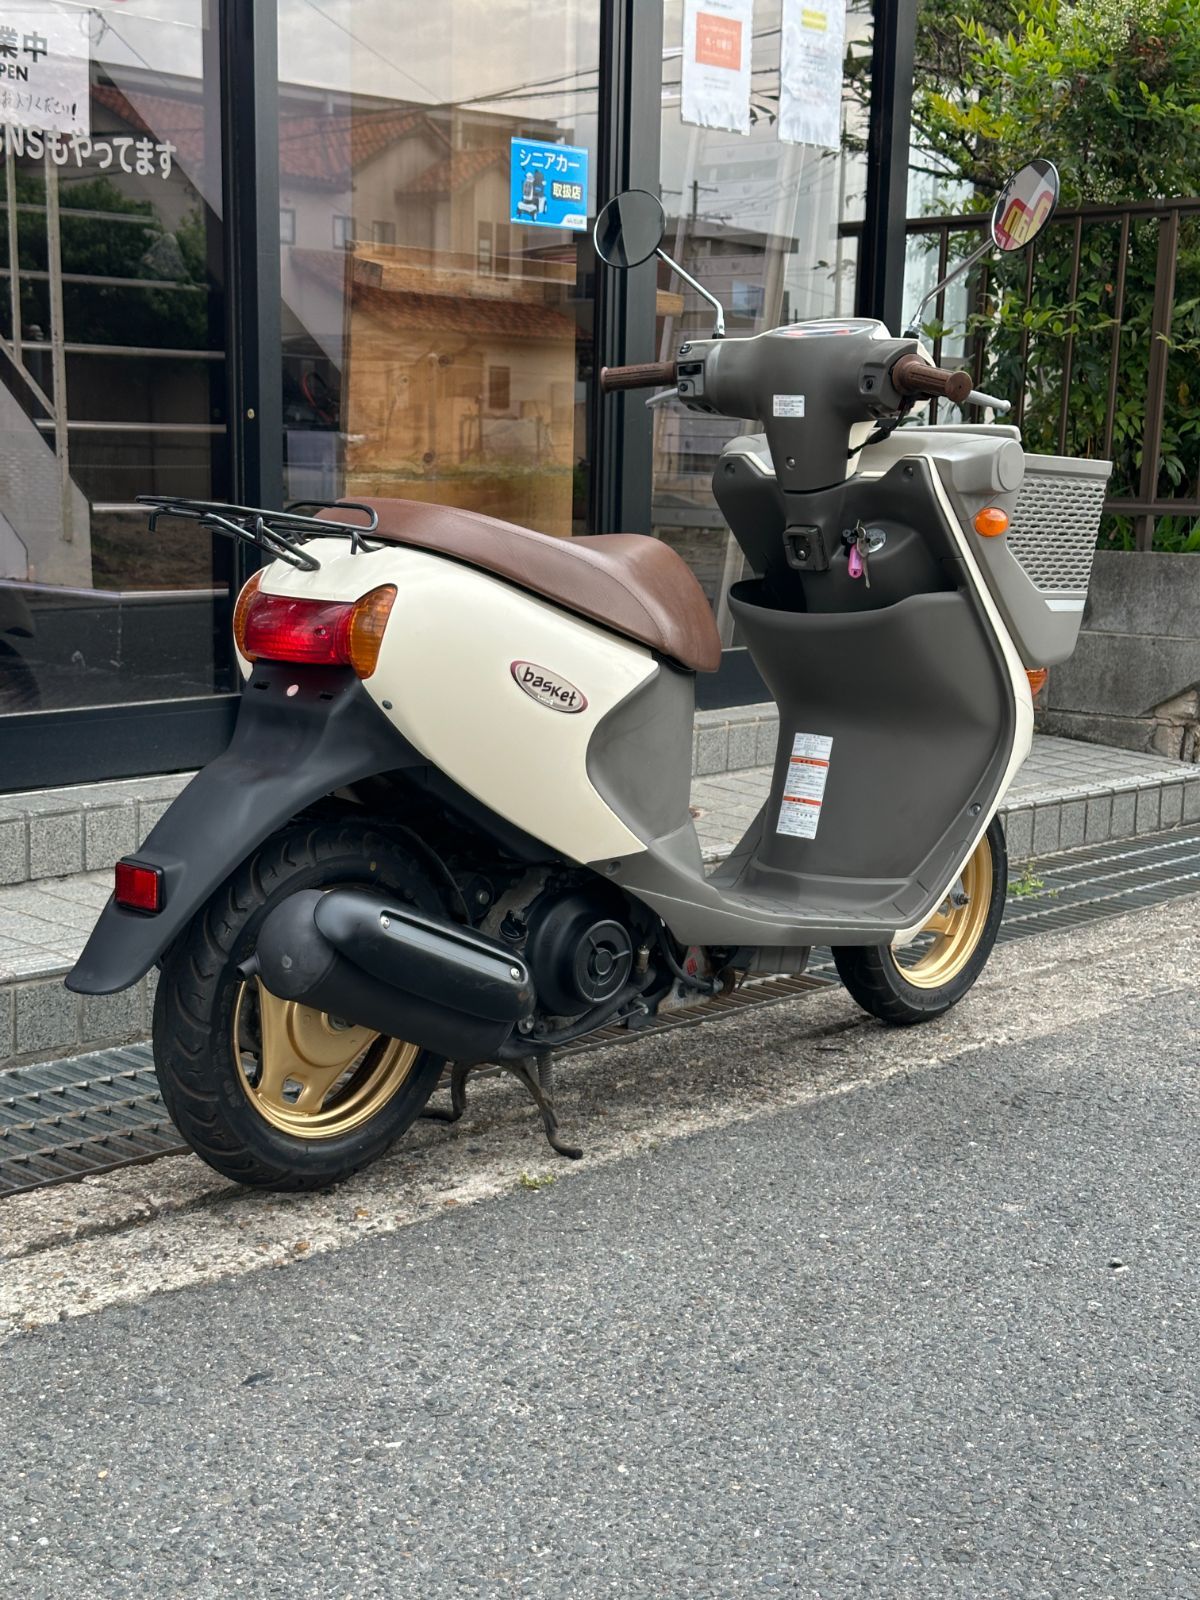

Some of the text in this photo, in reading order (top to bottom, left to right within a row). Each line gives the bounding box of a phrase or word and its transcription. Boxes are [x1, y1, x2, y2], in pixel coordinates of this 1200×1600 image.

[0, 25, 48, 63] 業中
[0, 63, 28, 82] PEN
[0, 122, 177, 180] NSもやってます
[520, 149, 580, 172] シニアカー
[552, 182, 582, 200] 取扱店
